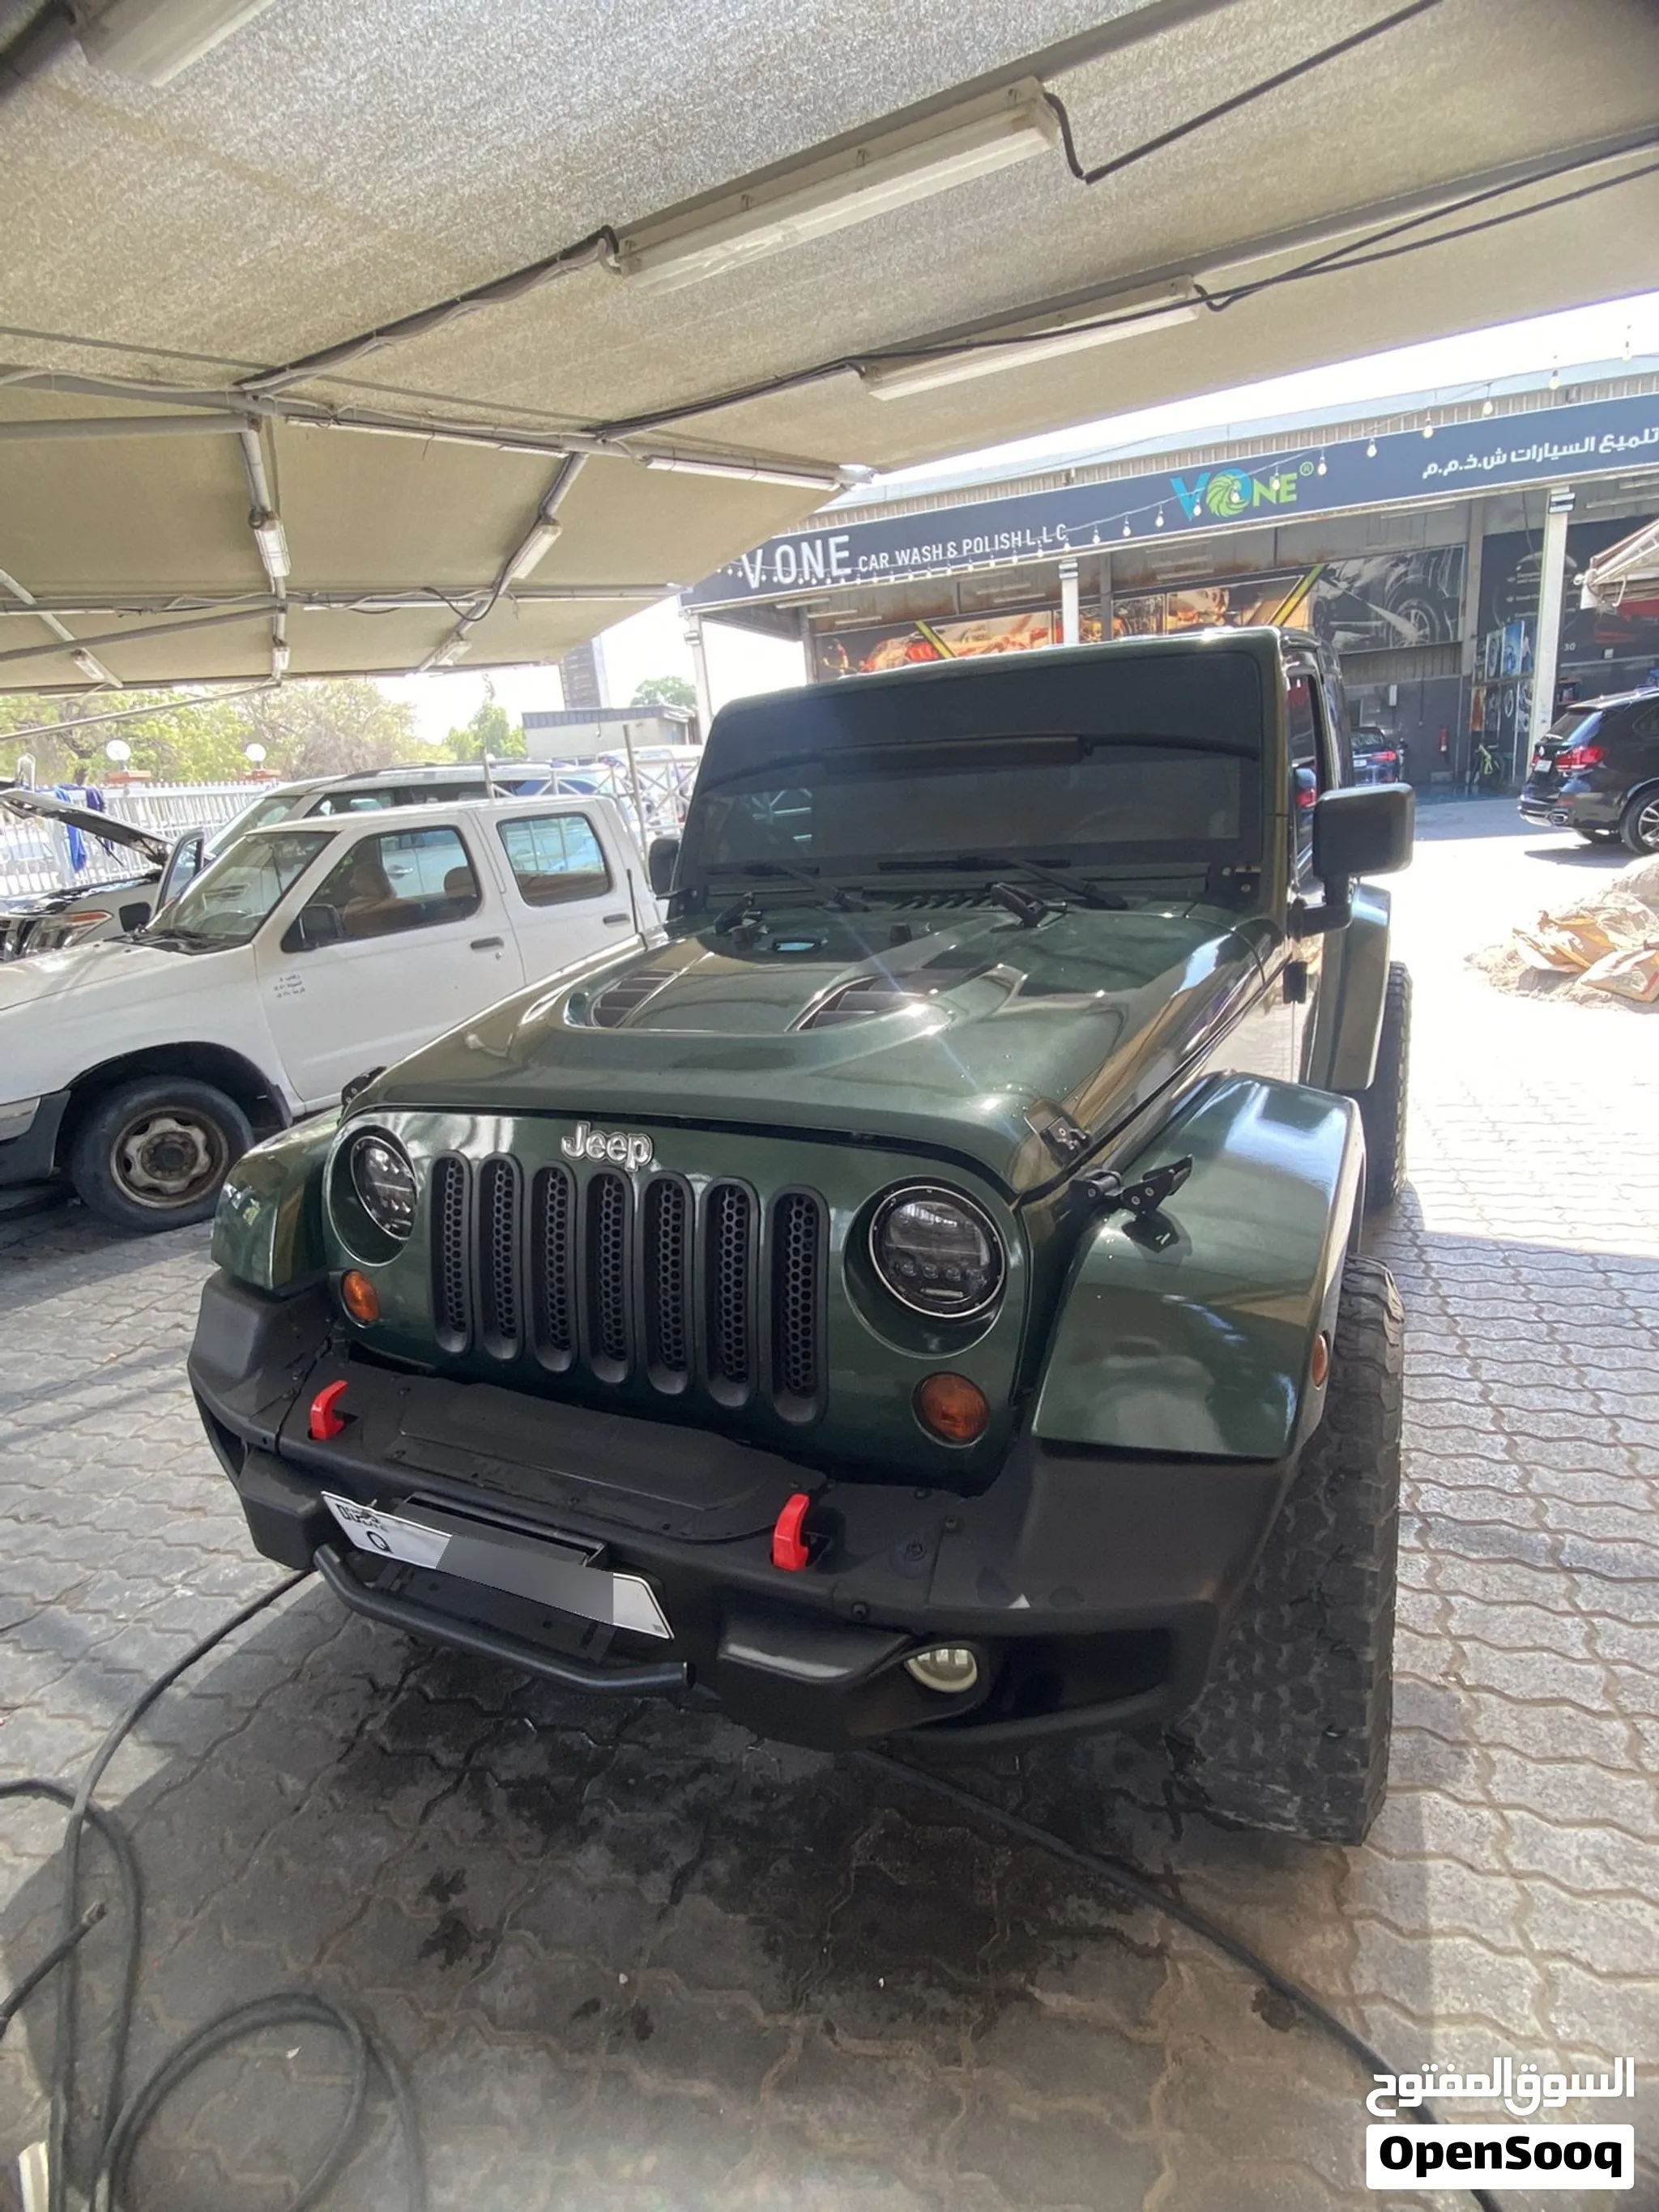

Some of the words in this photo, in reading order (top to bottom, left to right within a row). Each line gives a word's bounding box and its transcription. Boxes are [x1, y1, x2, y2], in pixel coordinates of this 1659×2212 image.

[1511, 436, 1596, 462] السيارات
[858, 552, 889, 572] CAR
[894, 543, 942, 567] WASH
[947, 541, 958, 559] &
[962, 531, 1022, 556] POLISH
[561, 1121, 655, 1172] Jeep
[366, 1531, 394, 1554] Q
